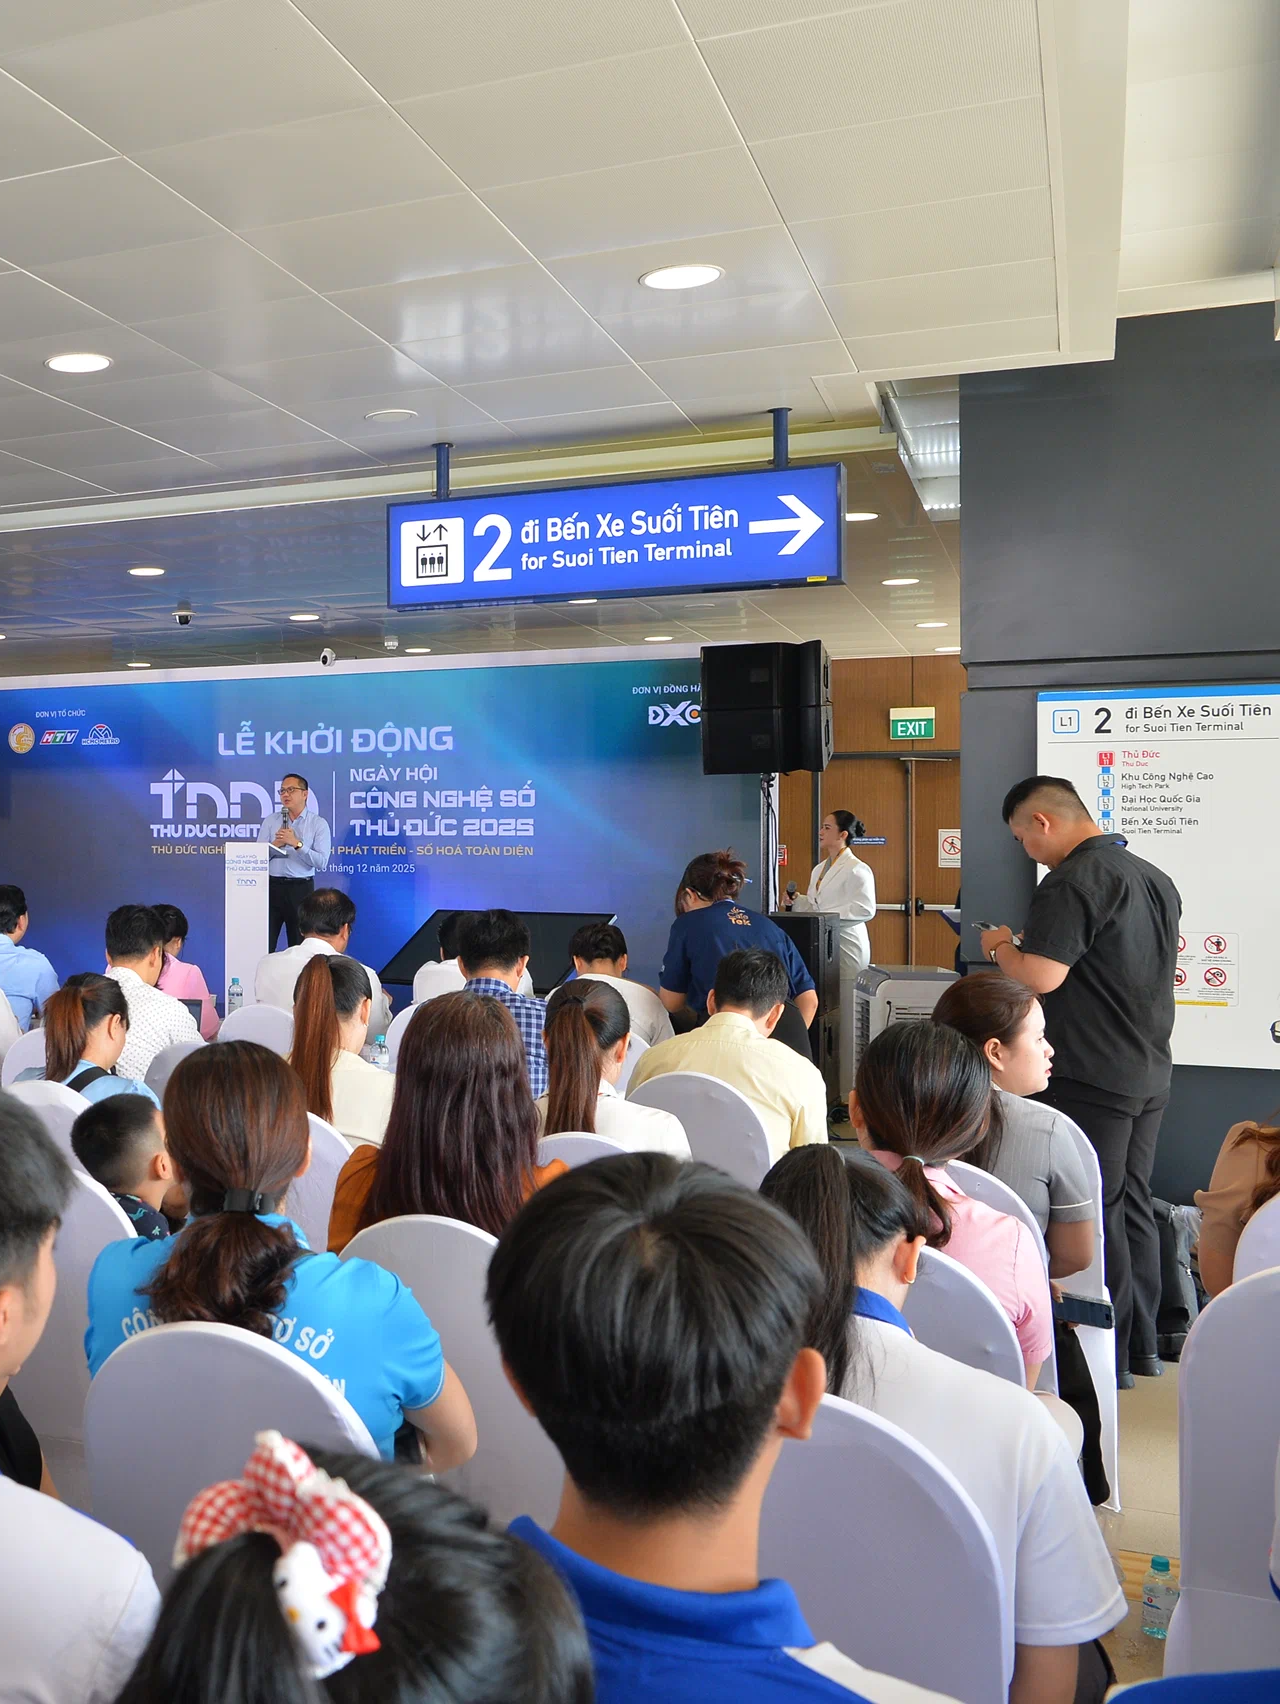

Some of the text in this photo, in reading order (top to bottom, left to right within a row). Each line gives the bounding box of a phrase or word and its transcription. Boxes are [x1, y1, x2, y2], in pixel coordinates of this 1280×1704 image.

[472, 503, 739, 582] 2 đi Bến Xe Suối Tiên
[521, 538, 733, 571] for Suoi Tien Terminal
[632, 686, 651, 694] ĐƠN
[653, 686, 662, 695] VỊ
[663, 683, 689, 694] ĐỒNG
[35, 710, 50, 718] ĐƠN
[1060, 702, 1272, 734] L1 2 đi Bến Xe Suối Tiên
[897, 721, 927, 736] EXIT
[1125, 721, 1244, 733] for Suoi Tien Terminal
[41, 731, 77, 744] HTV
[218, 720, 454, 758] LỄ KHỞI ĐỘNG
[1122, 750, 1160, 759] Thủ Đức
[350, 763, 438, 784] NGÀY HỘI
[1121, 772, 1214, 783] Khu Công Nghệ Cao
[350, 780, 536, 812] CÔNG NGHỆ SỐ
[1121, 793, 1201, 805] Đại Học Quốc Gia
[1149, 805, 1183, 813] University
[350, 811, 535, 837] THỦ ĐỨC 2025
[1121, 816, 1199, 826] Bến Xe Suối Tiên
[150, 824, 261, 838] THU DUC DIGIT
[151, 843, 173, 855] THỦ
[174, 842, 198, 855] ĐỨC
[337, 843, 370, 856] PHÁT
[371, 842, 407, 856] TRIỂN
[416, 842, 434, 856] SỐ
[436, 842, 463, 856] HOÁ
[465, 842, 500, 856] TOÀN
[503, 844, 534, 858] DIỆN
[329, 863, 354, 875] tháng
[356, 864, 368, 873] 12
[370, 864, 390, 873] năm
[392, 864, 416, 873] 2025
[294, 1328, 335, 1360] SỞ
